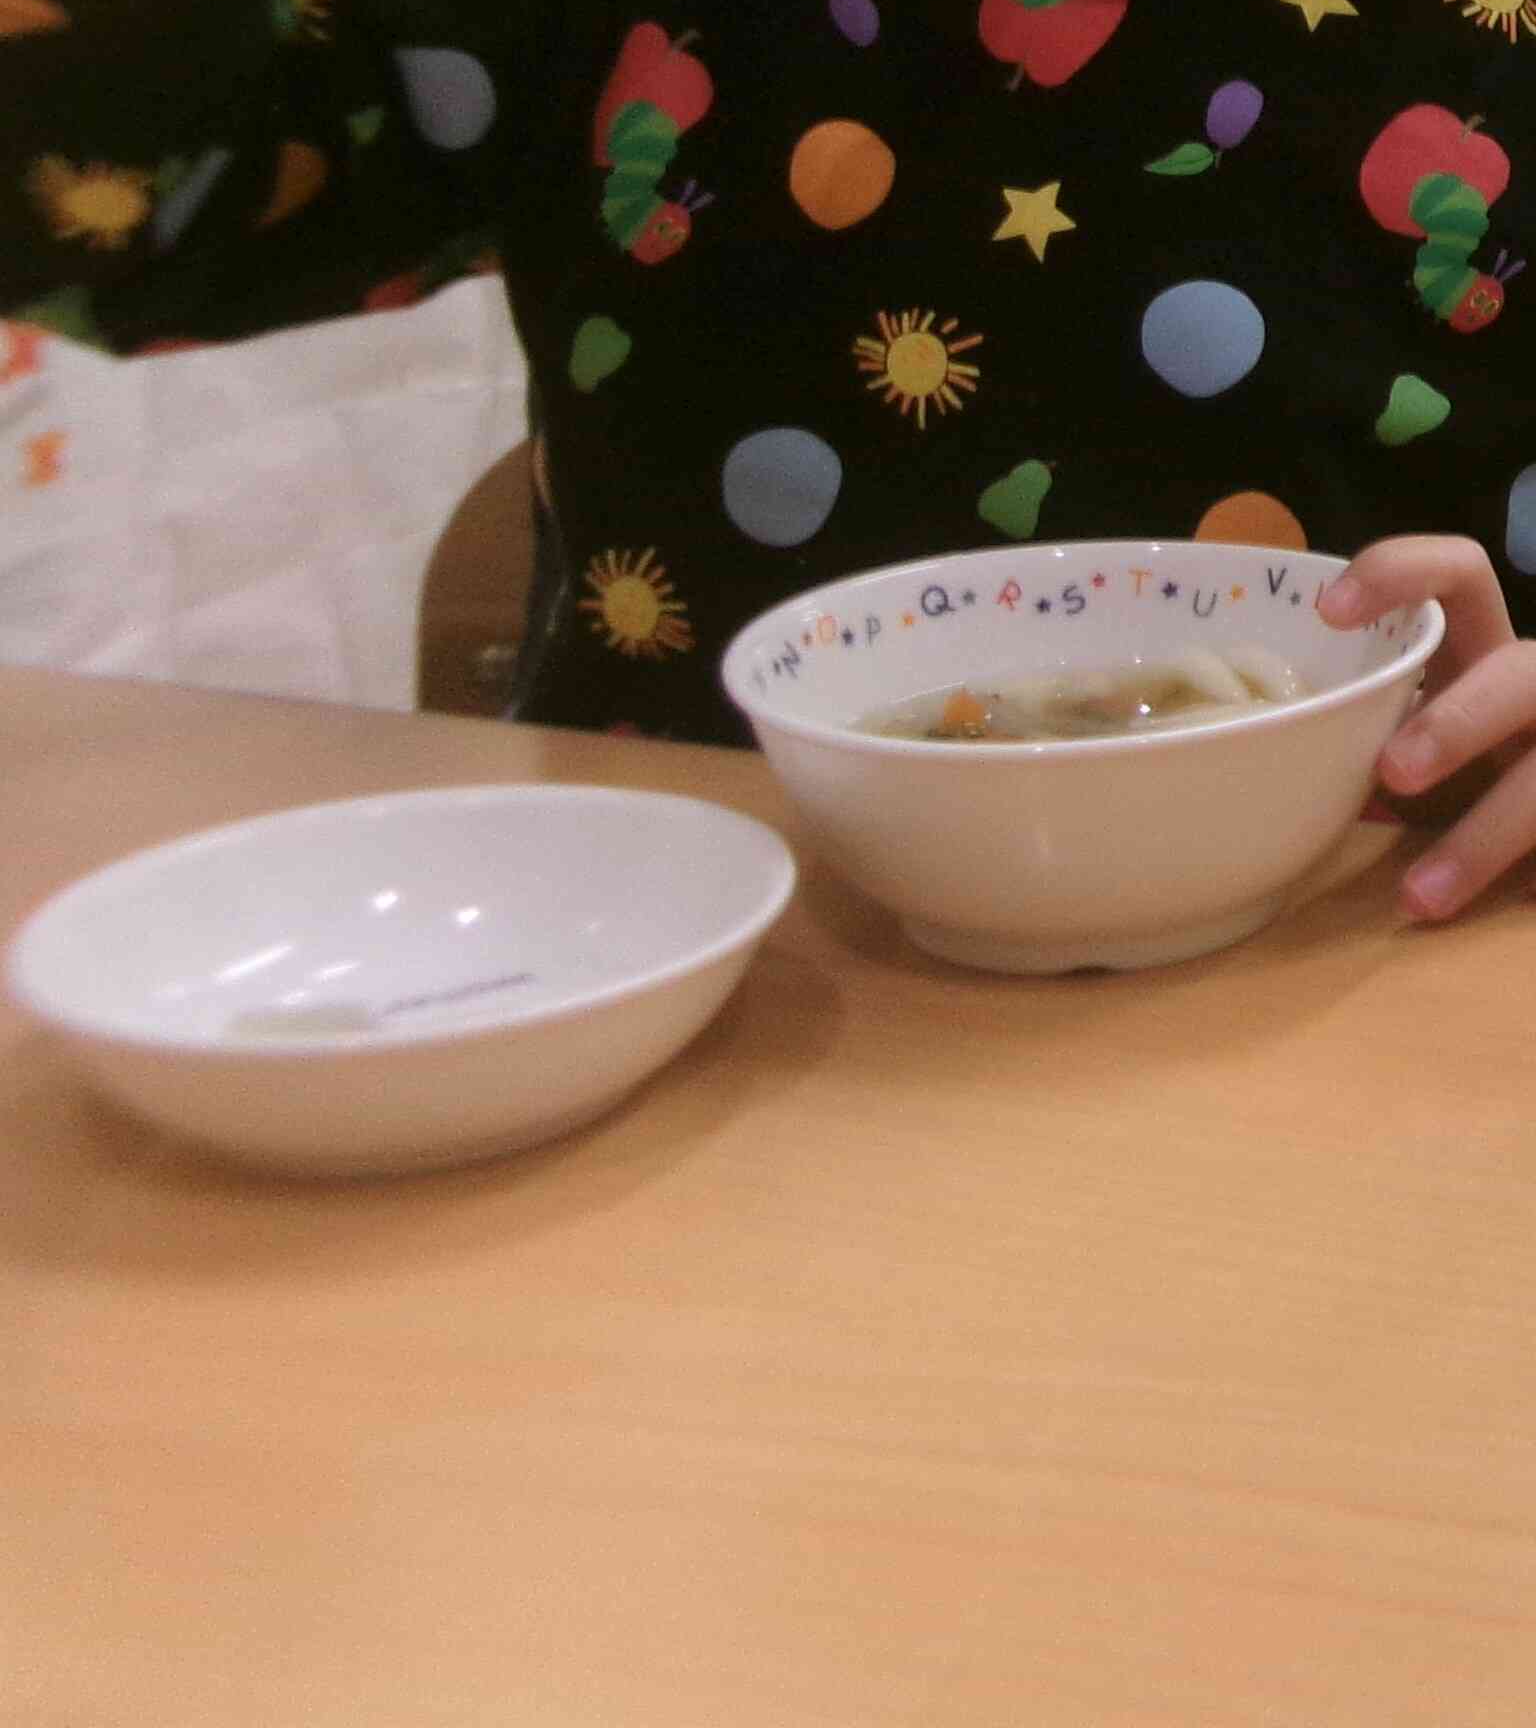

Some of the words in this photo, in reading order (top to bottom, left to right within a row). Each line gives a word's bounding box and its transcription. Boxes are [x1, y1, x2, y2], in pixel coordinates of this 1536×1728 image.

[921, 584, 956, 617] Q
[996, 577, 1023, 611] R
[1062, 583, 1086, 615] S
[1128, 568, 1153, 597] T
[1193, 588, 1218, 618] U
[1266, 567, 1288, 597] V
